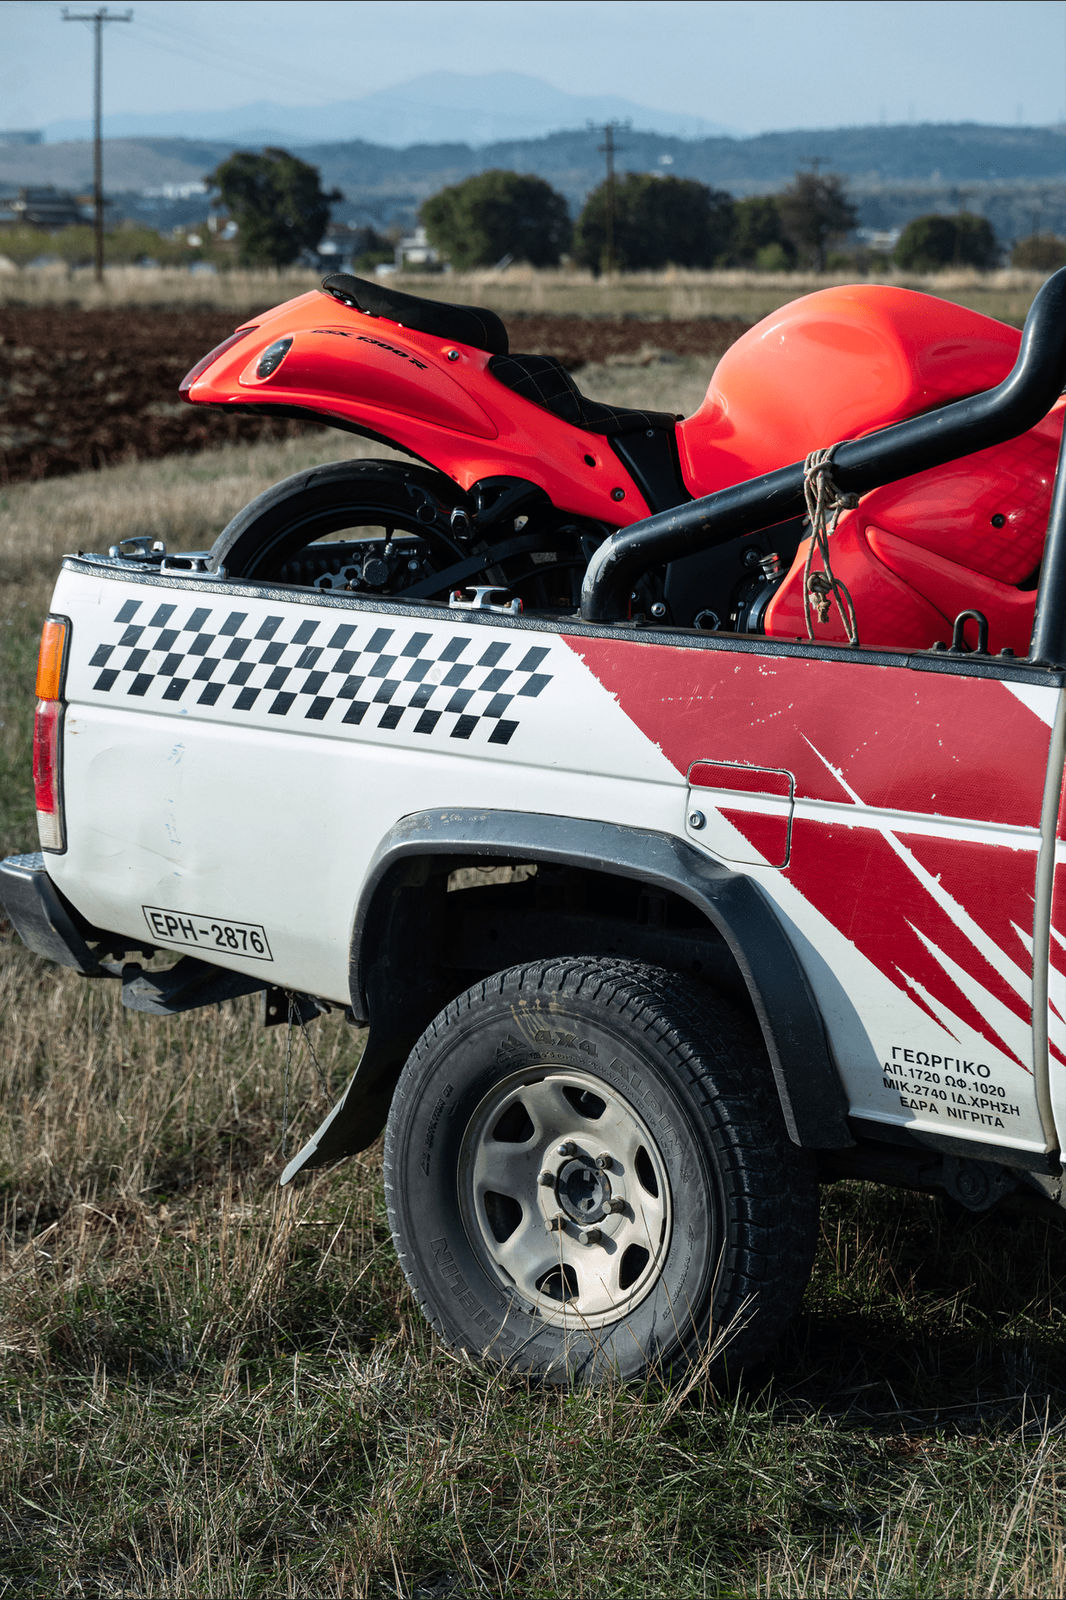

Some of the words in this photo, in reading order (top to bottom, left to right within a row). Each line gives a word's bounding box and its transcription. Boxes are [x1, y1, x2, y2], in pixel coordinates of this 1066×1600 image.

[409, 357, 428, 370] R
[150, 912, 264, 954] EPH-2876
[891, 1046, 991, 1078] ΓΕΩΡΓΙΚΟ
[882, 1077, 947, 1101] ΜΙΚ.2740
[883, 1062, 940, 1084] ΑΠ.1720
[945, 1075, 1006, 1098] ΩΦ.1020
[900, 1096, 939, 1114] ΕΔΡΑ
[947, 1106, 1005, 1128] ΝΙΓΡΙΤΑ
